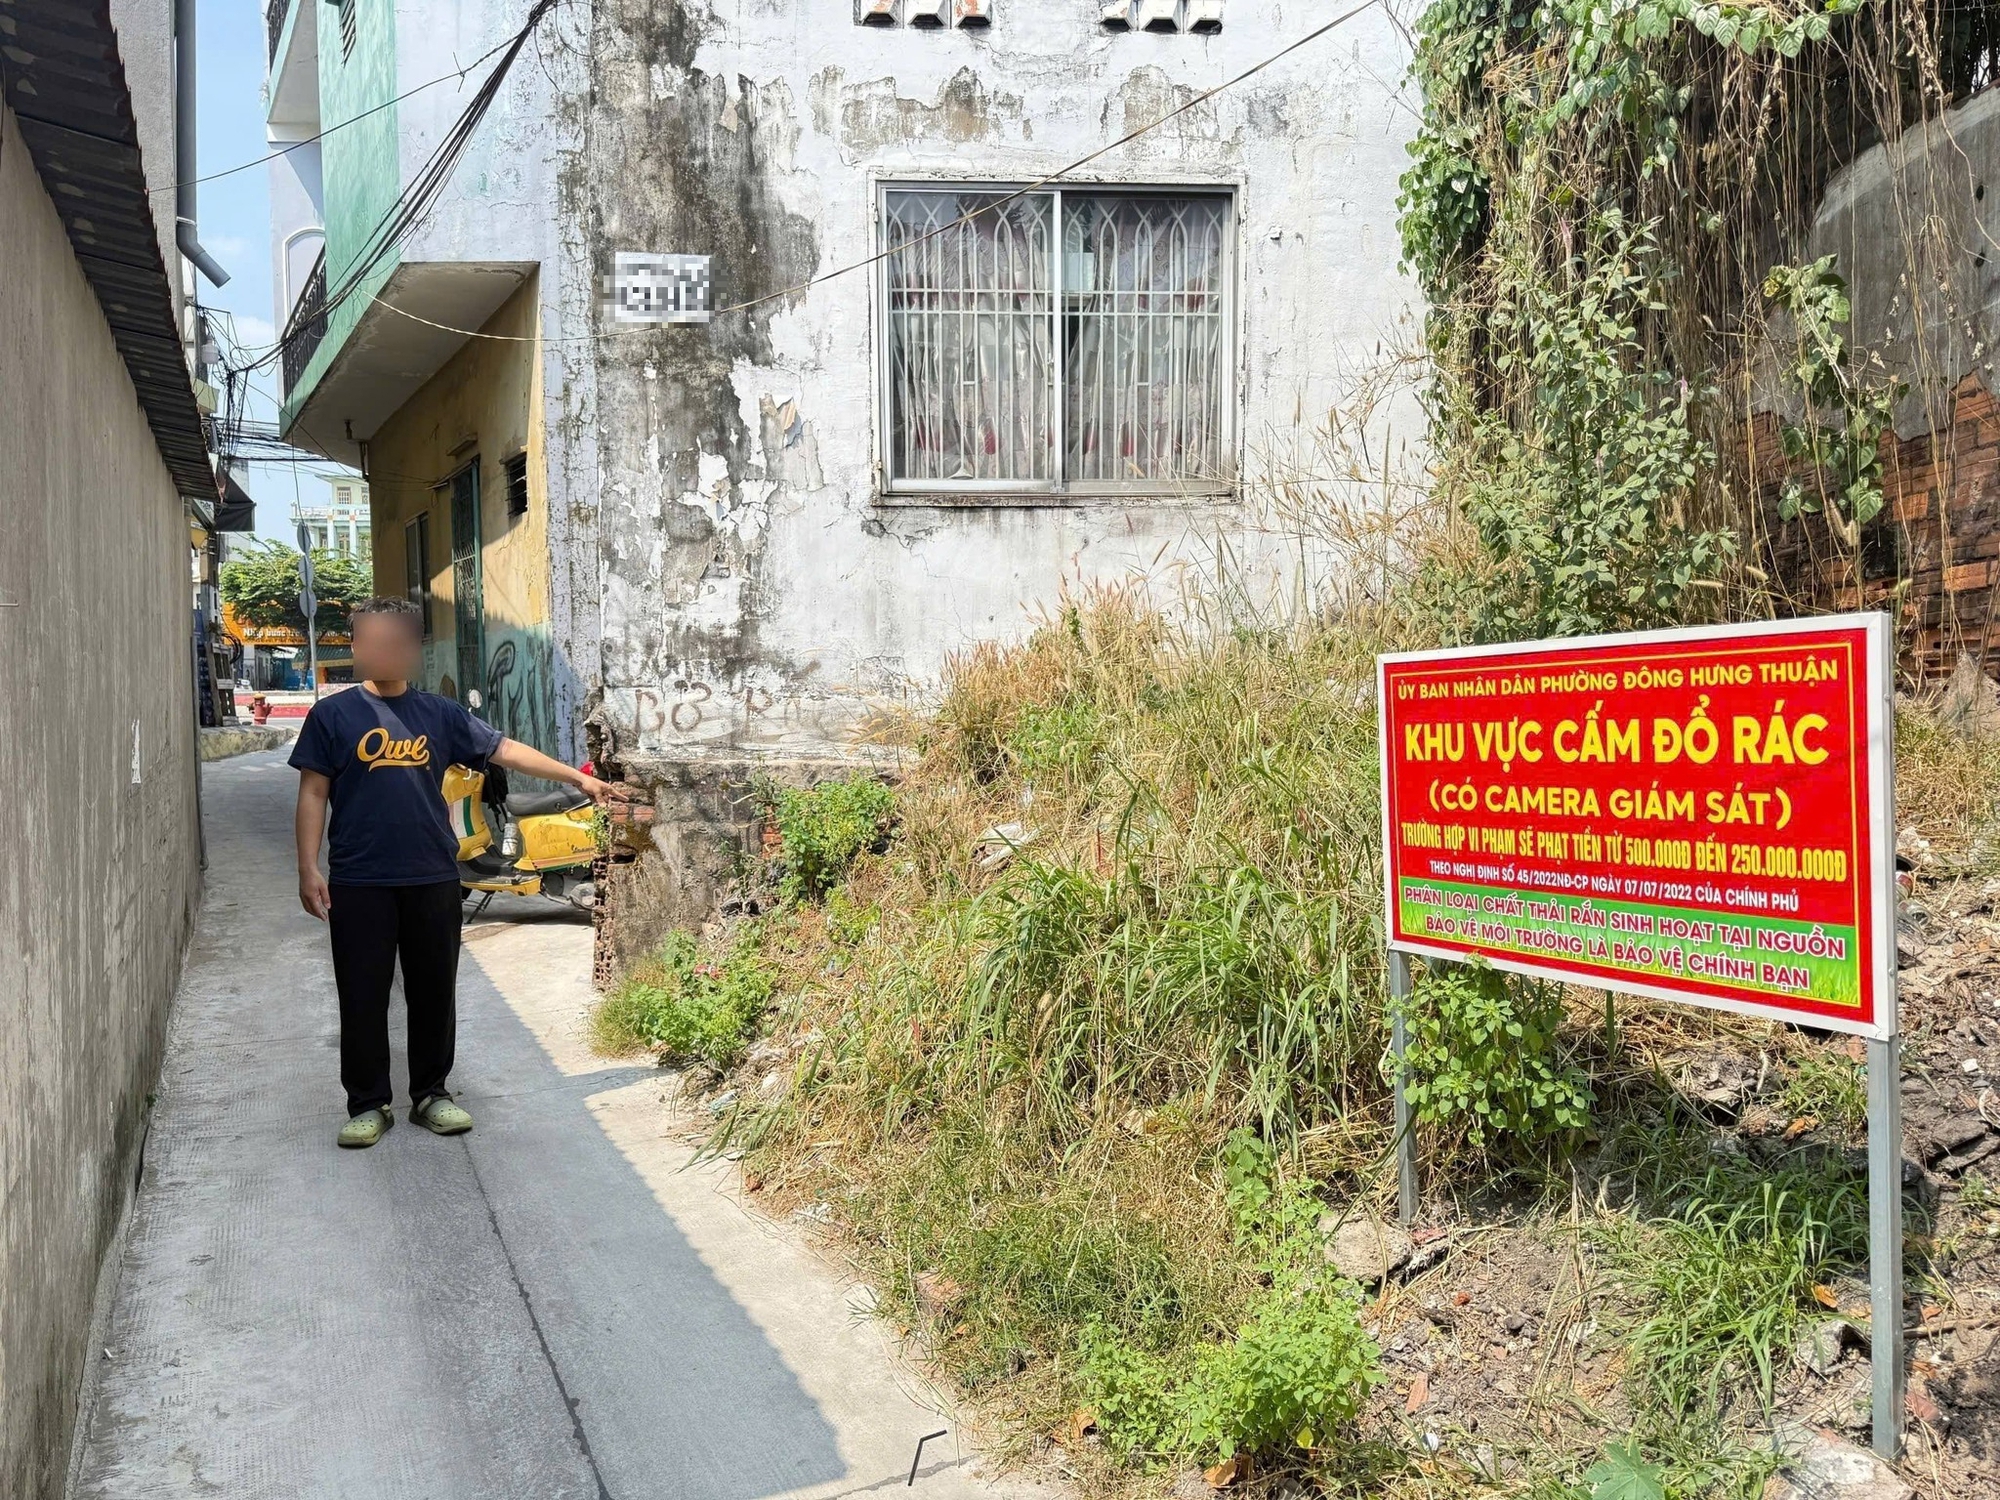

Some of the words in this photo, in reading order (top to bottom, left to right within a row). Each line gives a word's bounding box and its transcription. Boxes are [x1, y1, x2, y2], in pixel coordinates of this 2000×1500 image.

[1398, 679, 1415, 700] ỦY
[1420, 682, 1449, 699] BAN
[1453, 676, 1496, 698] NHÂN
[1501, 674, 1536, 695] DÂN
[1541, 669, 1617, 693] PHƯỜNG
[1623, 666, 1684, 689] ĐÔNG
[1690, 664, 1752, 687] HƯNG
[1759, 655, 1838, 687] THUẬN
[1405, 722, 1464, 762] KHU
[1472, 716, 1543, 773] VỰC
[1553, 700, 1640, 763] CẤM
[1652, 694, 1719, 764] ĐỔ
[1733, 699, 1830, 765] RÁC
[1429, 777, 1478, 812] (CÓ
[1485, 785, 1601, 817] CAMERA
[1609, 781, 1695, 821] GIÁM
[1706, 782, 1792, 830] SÁT)
[1401, 818, 1441, 848] TRƯỜNG
[1444, 823, 1465, 855] HỢP
[1468, 826, 1479, 852] VI
[1482, 827, 1515, 859] PHẠM
[1519, 825, 1534, 857] SẼ
[1537, 831, 1569, 865] PHẠT
[1572, 825, 1602, 863] TIỀN
[1605, 830, 1623, 864] TỪ
[1625, 837, 1691, 870] 500.000Đ
[1695, 832, 1727, 873] ĐẾN
[1731, 844, 1847, 883] 250.000.000Đ
[1430, 860, 1450, 875] THEO
[1454, 863, 1476, 881] NGHỊ
[1477, 865, 1500, 883] ĐỊNH
[1502, 863, 1515, 883] SỐ
[1517, 871, 1589, 889] 45/2022NĐ-CP
[1592, 875, 1621, 894] NGÀY
[1625, 880, 1692, 900] 07/07/2022
[1695, 882, 1722, 904] CỦA
[1725, 885, 1768, 908] CHÍNH
[1772, 888, 1799, 912] PHỦ
[1405, 885, 1442, 907] PHÂN
[1446, 892, 1478, 917] LOẠI
[1483, 892, 1525, 918] CHẤT
[1528, 898, 1565, 922] THẢI
[1569, 900, 1606, 930] RẮN
[1610, 911, 1653, 935] SINH
[1659, 917, 1714, 946] HOẠT
[1718, 925, 1751, 951] TẠI
[1758, 924, 1845, 960] NGUỒN
[1426, 911, 1455, 934] BẢO
[1460, 917, 1477, 942] VỆ
[1482, 922, 1510, 943] MÔI
[1515, 925, 1583, 954] TRƯỜNG
[1588, 936, 1609, 959] LÀ
[1613, 939, 1653, 966] BẢO
[1658, 946, 1683, 975] VỆ
[1688, 953, 1756, 981] CHÍNH
[1761, 963, 1810, 991] BẠN
